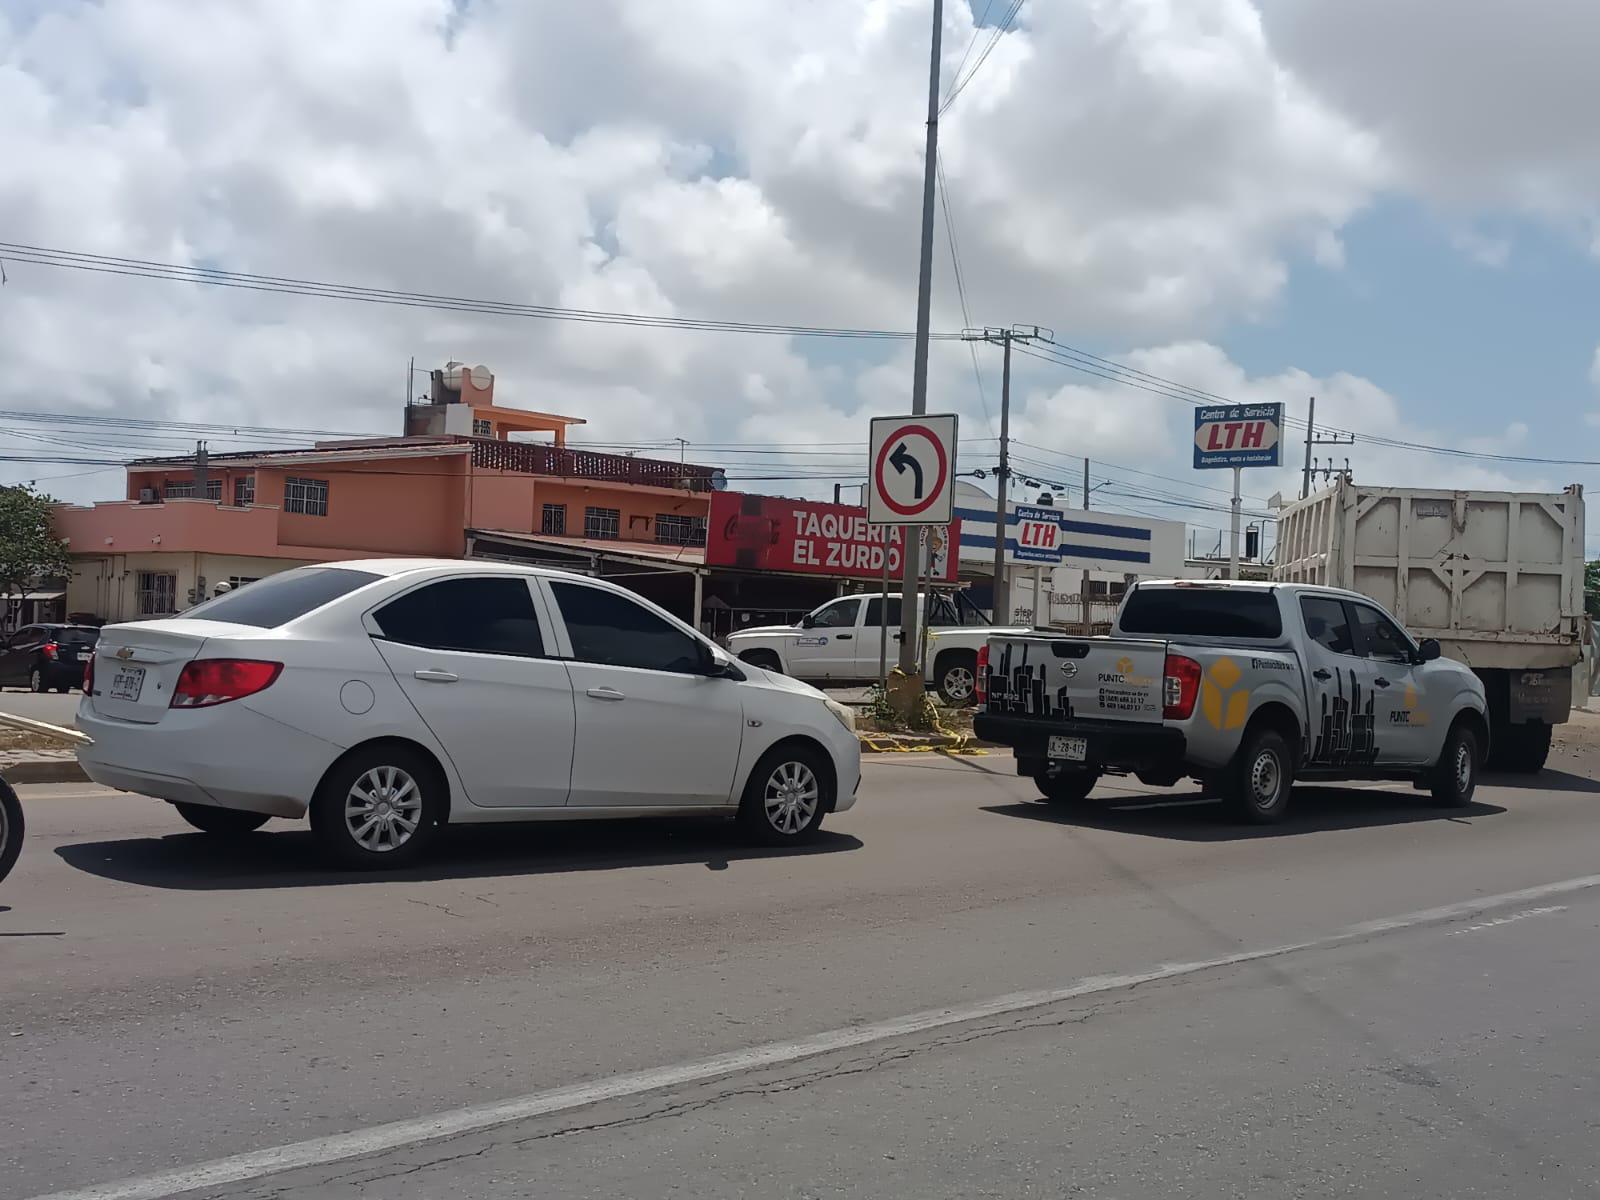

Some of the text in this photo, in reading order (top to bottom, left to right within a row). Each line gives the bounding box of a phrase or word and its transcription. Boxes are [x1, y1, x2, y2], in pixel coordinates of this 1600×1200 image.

[1201, 406, 1275, 420] Centro de Servicio
[1207, 422, 1265, 450] LTH
[1021, 522, 1056, 547] LTH
[793, 539, 900, 571] EL ZURDO
